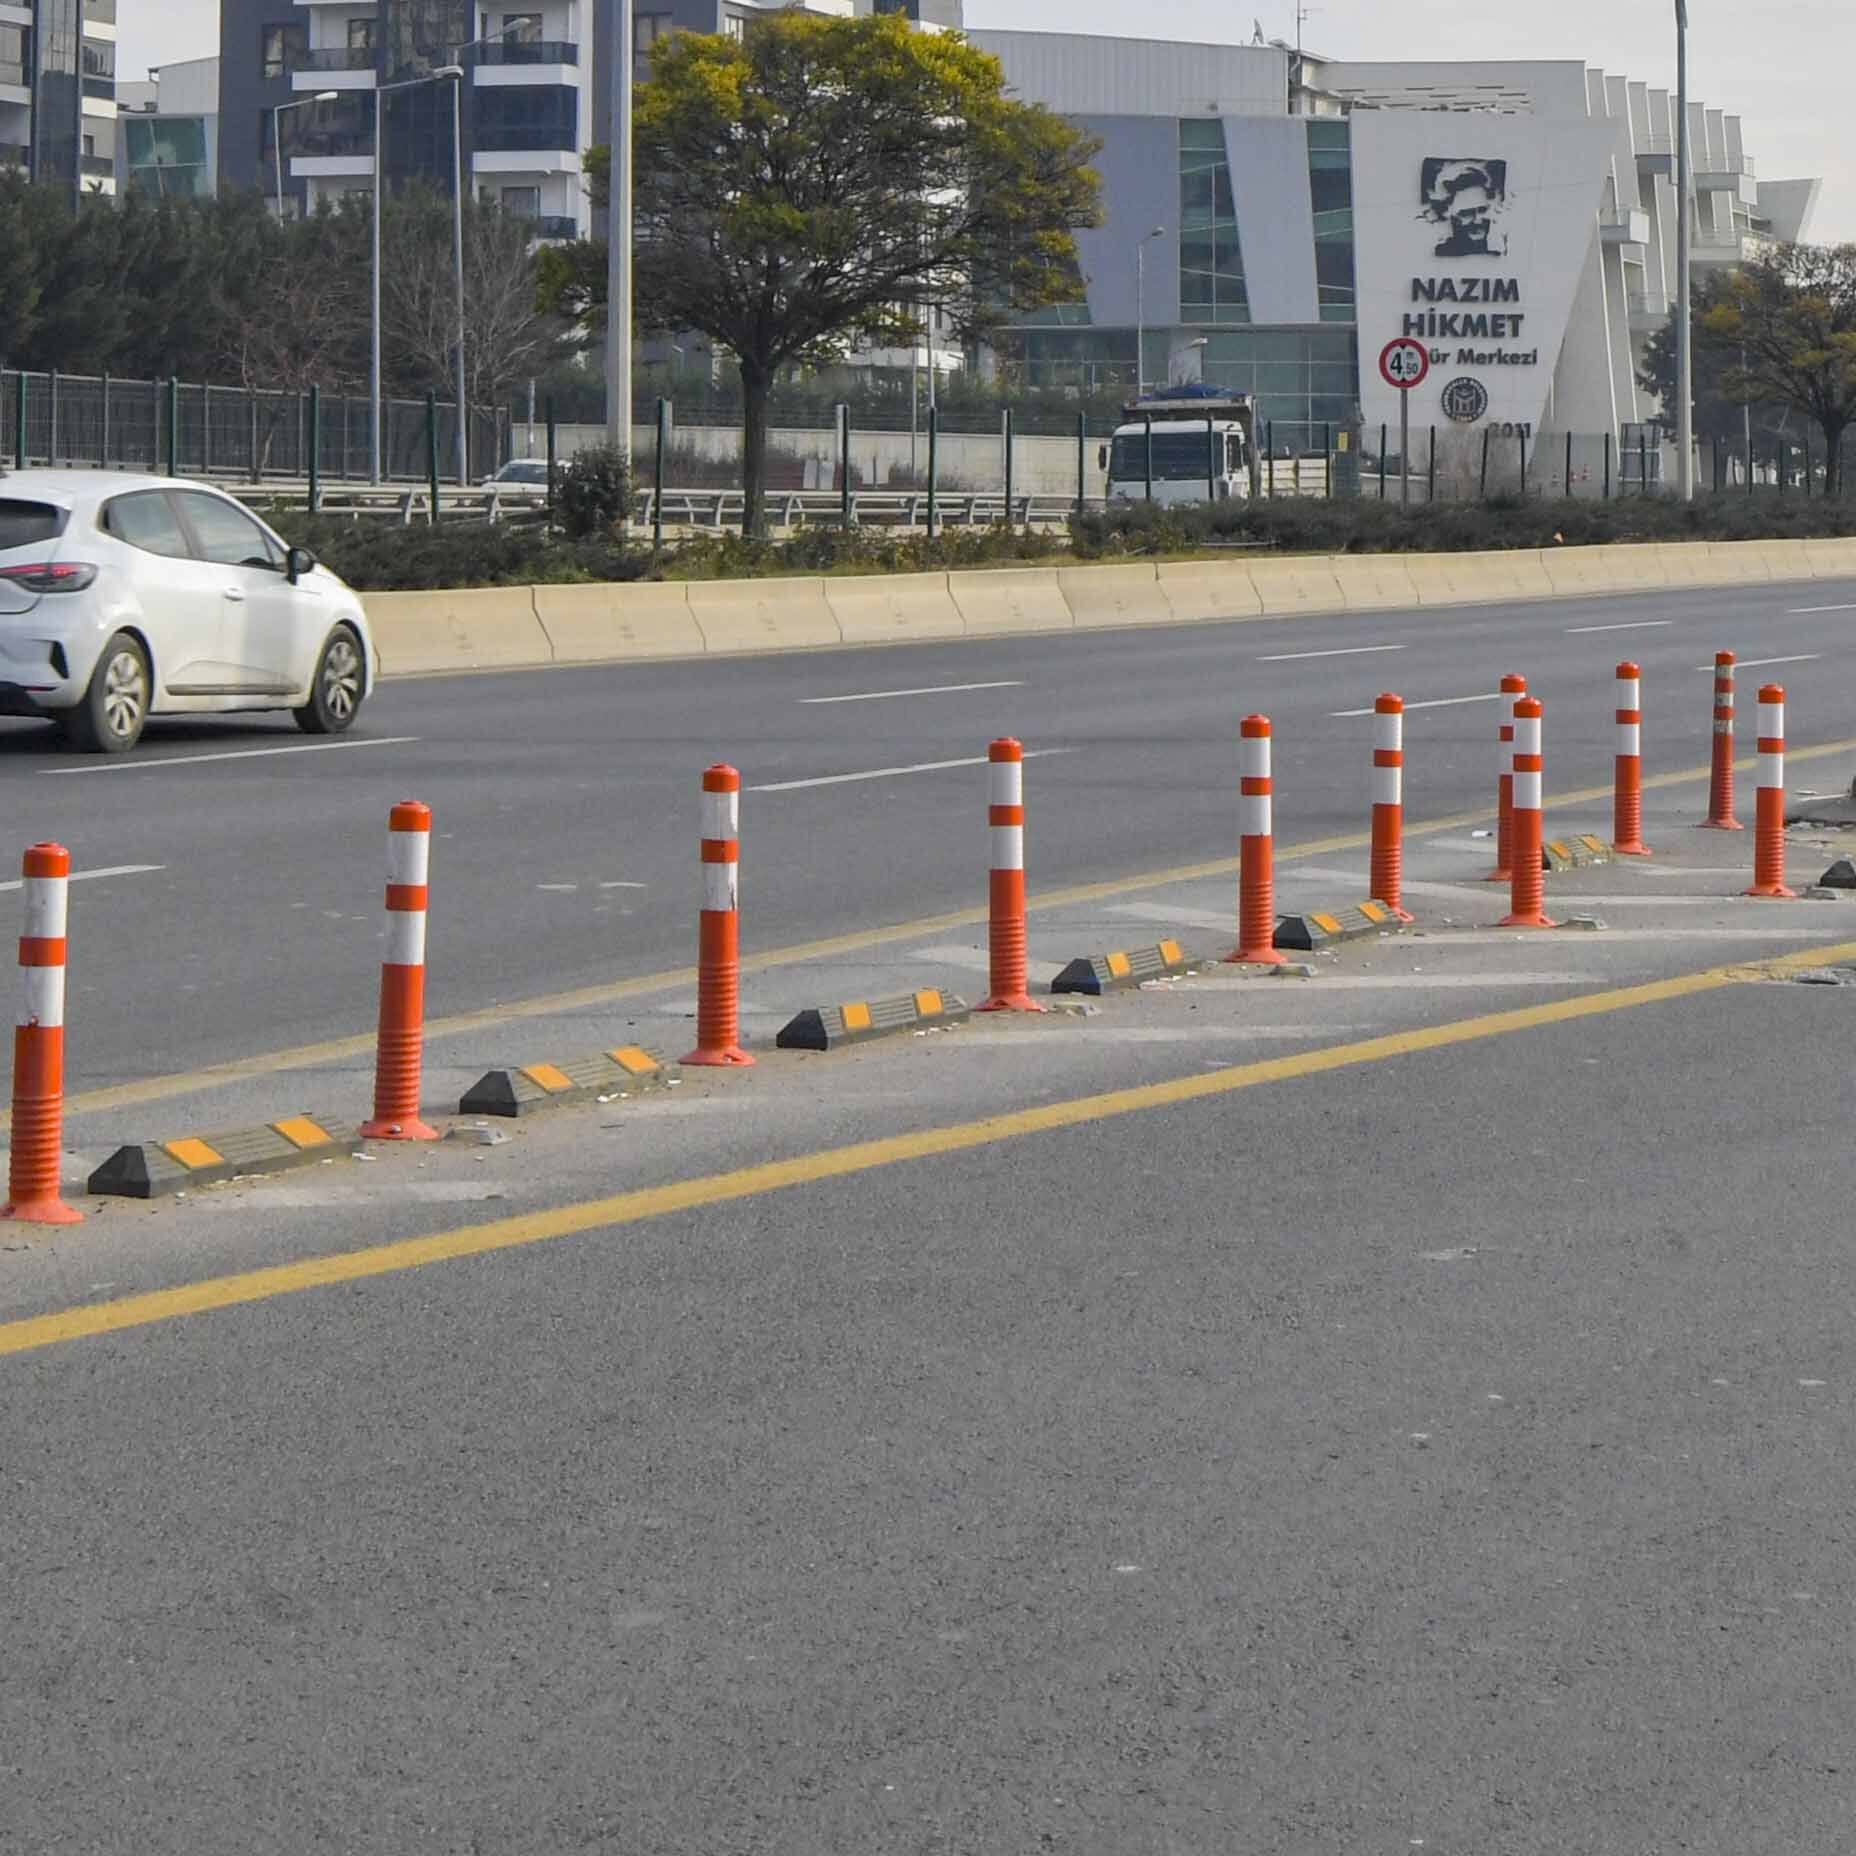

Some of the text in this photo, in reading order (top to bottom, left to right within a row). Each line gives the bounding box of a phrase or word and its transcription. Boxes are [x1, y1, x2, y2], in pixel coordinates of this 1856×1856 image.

[1411, 277, 1520, 304] NAZIM
[1402, 307, 1525, 338] HİKMET
[1456, 348, 1538, 366] Merkezi
